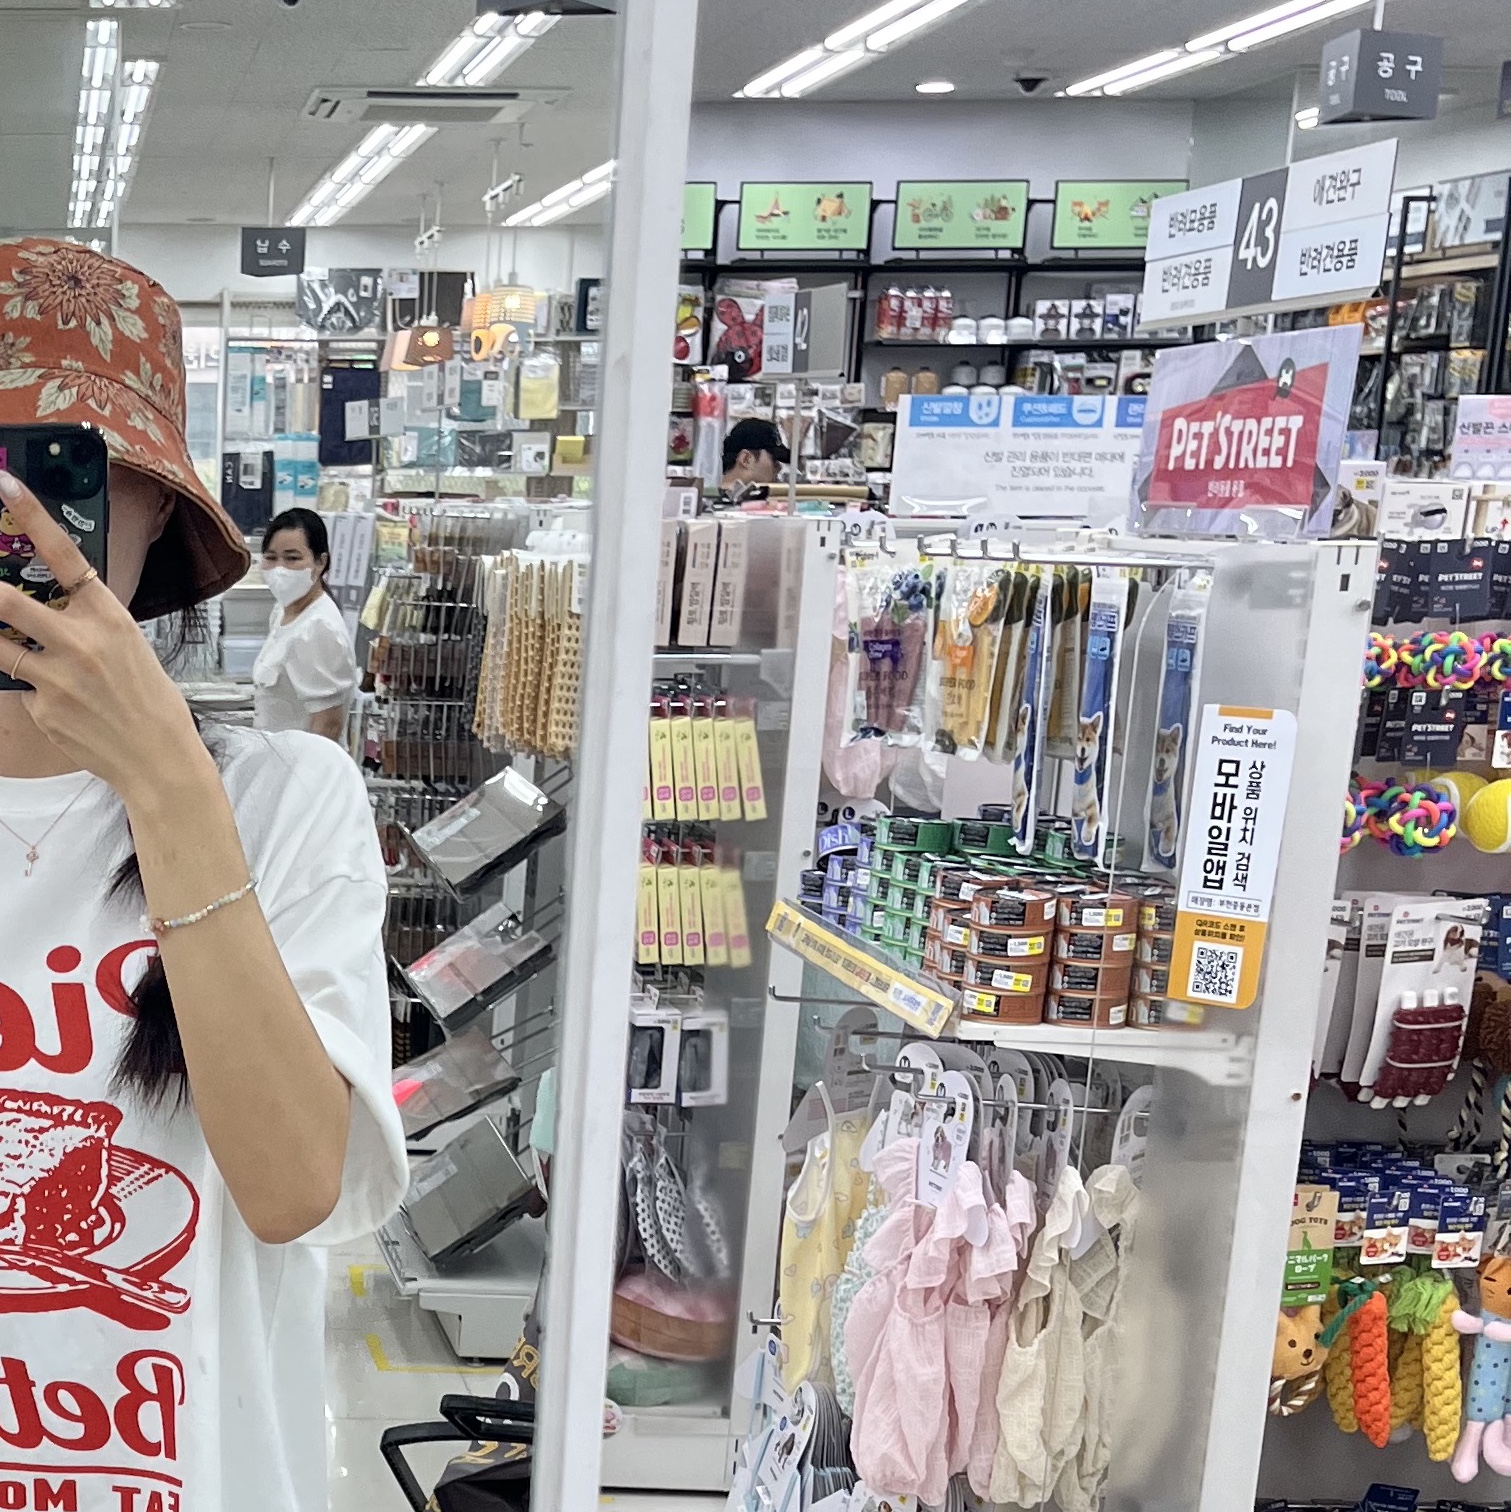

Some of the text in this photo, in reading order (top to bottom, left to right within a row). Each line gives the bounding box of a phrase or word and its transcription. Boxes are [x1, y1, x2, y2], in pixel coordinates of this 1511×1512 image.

[1377, 52, 1423, 80] 공구
[1314, 168, 1362, 205] 애견완구
[1238, 197, 1279, 270] 43
[1299, 239, 1359, 276] 반려견용품
[1168, 410, 1304, 471] PET'STREET
[1210, 736, 1277, 751] Product Here!
[1223, 722, 1269, 737] Find Your
[1202, 757, 1242, 891] 모바일앱
[1231, 760, 1267, 892] 상품 위치 검색
